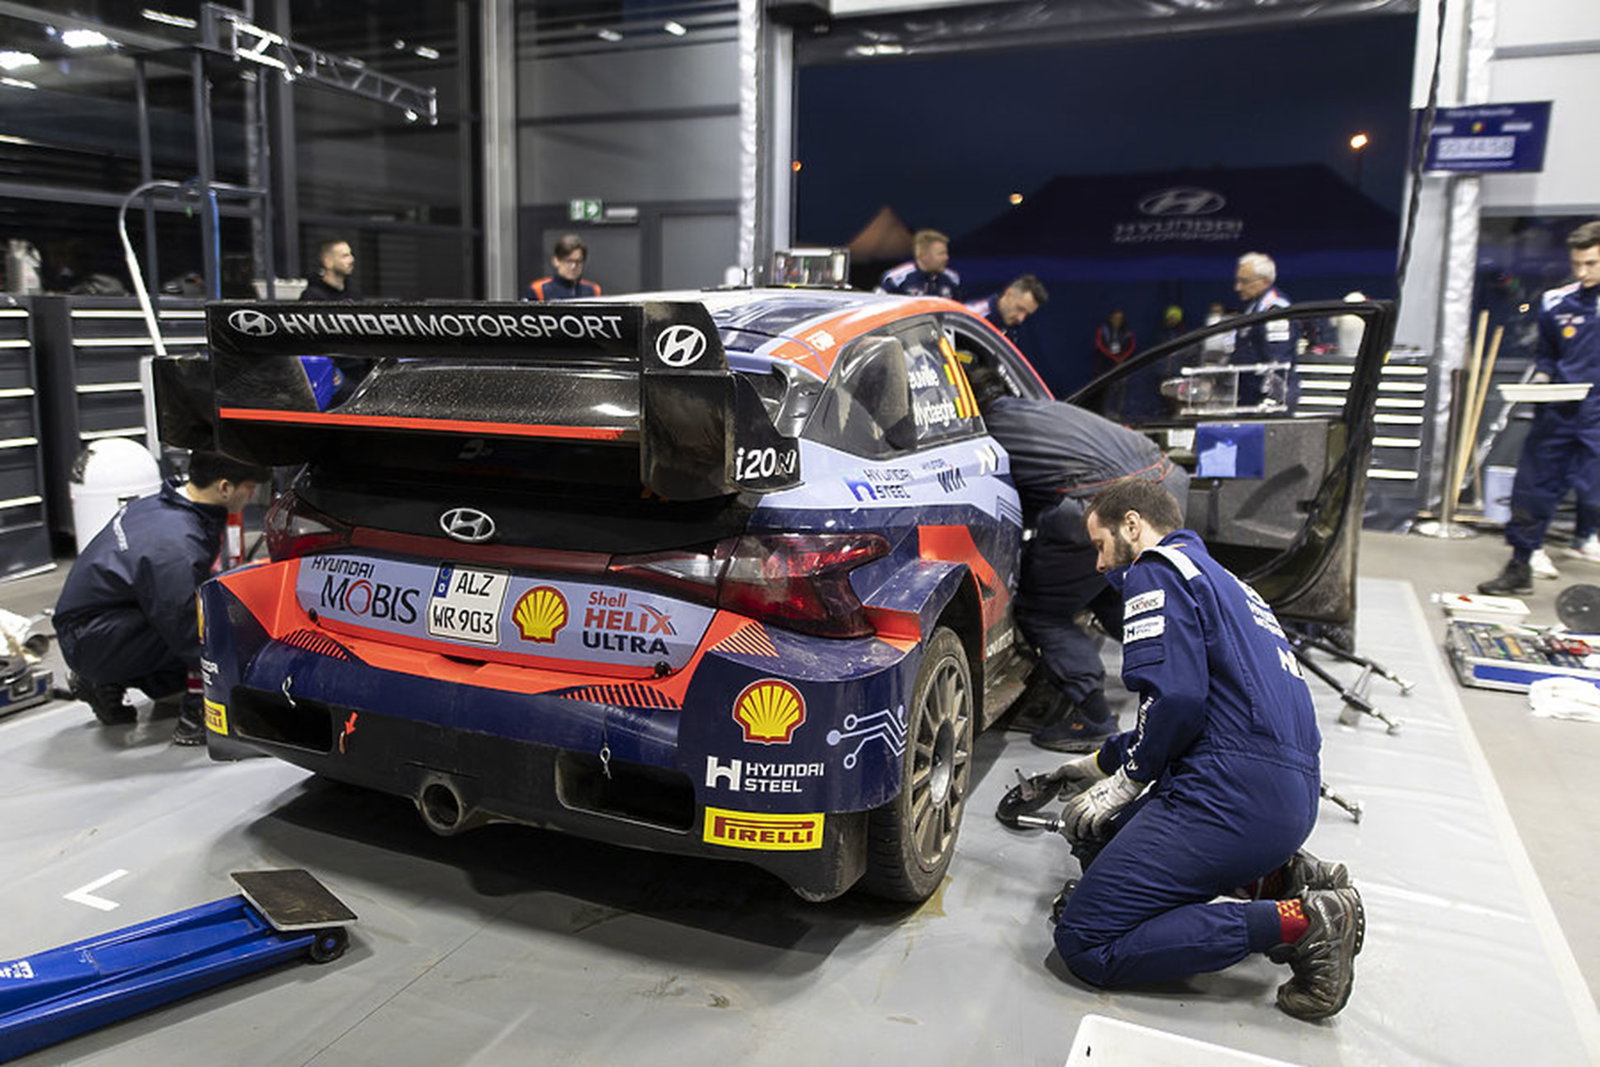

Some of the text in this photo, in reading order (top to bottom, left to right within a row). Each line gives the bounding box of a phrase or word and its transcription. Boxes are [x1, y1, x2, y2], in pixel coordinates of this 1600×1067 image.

[278, 314, 622, 339] HYUNDAI MOTORSPORT
[907, 365, 940, 389] euville
[863, 468, 915, 483] HYUNDAI
[875, 484, 912, 499] STEEL
[311, 555, 375, 579] HYUNDAI
[455, 572, 495, 597] ALZ
[321, 575, 420, 624] MOBIS
[587, 590, 628, 608] Shell
[433, 605, 494, 634] WR 903
[583, 606, 673, 636] HELIX
[582, 630, 670, 655] ULTRA
[745, 762, 824, 778] HYUNDAI
[744, 778, 803, 792] STEEL
[713, 815, 816, 844] PIRELLI
